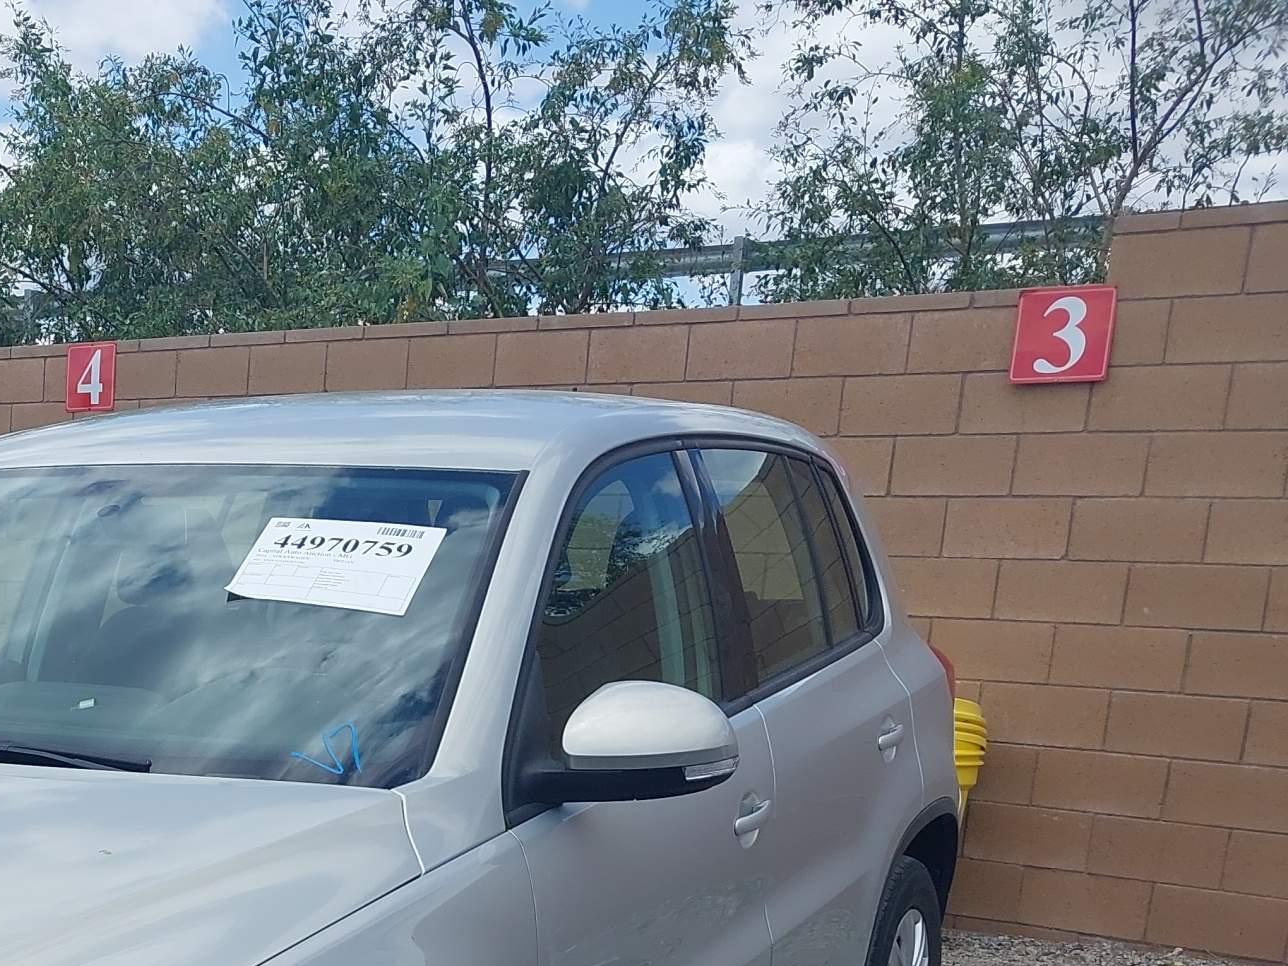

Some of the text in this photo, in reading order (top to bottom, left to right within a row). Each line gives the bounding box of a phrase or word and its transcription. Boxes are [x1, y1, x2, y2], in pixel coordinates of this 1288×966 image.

[1033, 296, 1087, 374] 3
[77, 349, 103, 404] 4
[274, 534, 413, 558] 44970759
